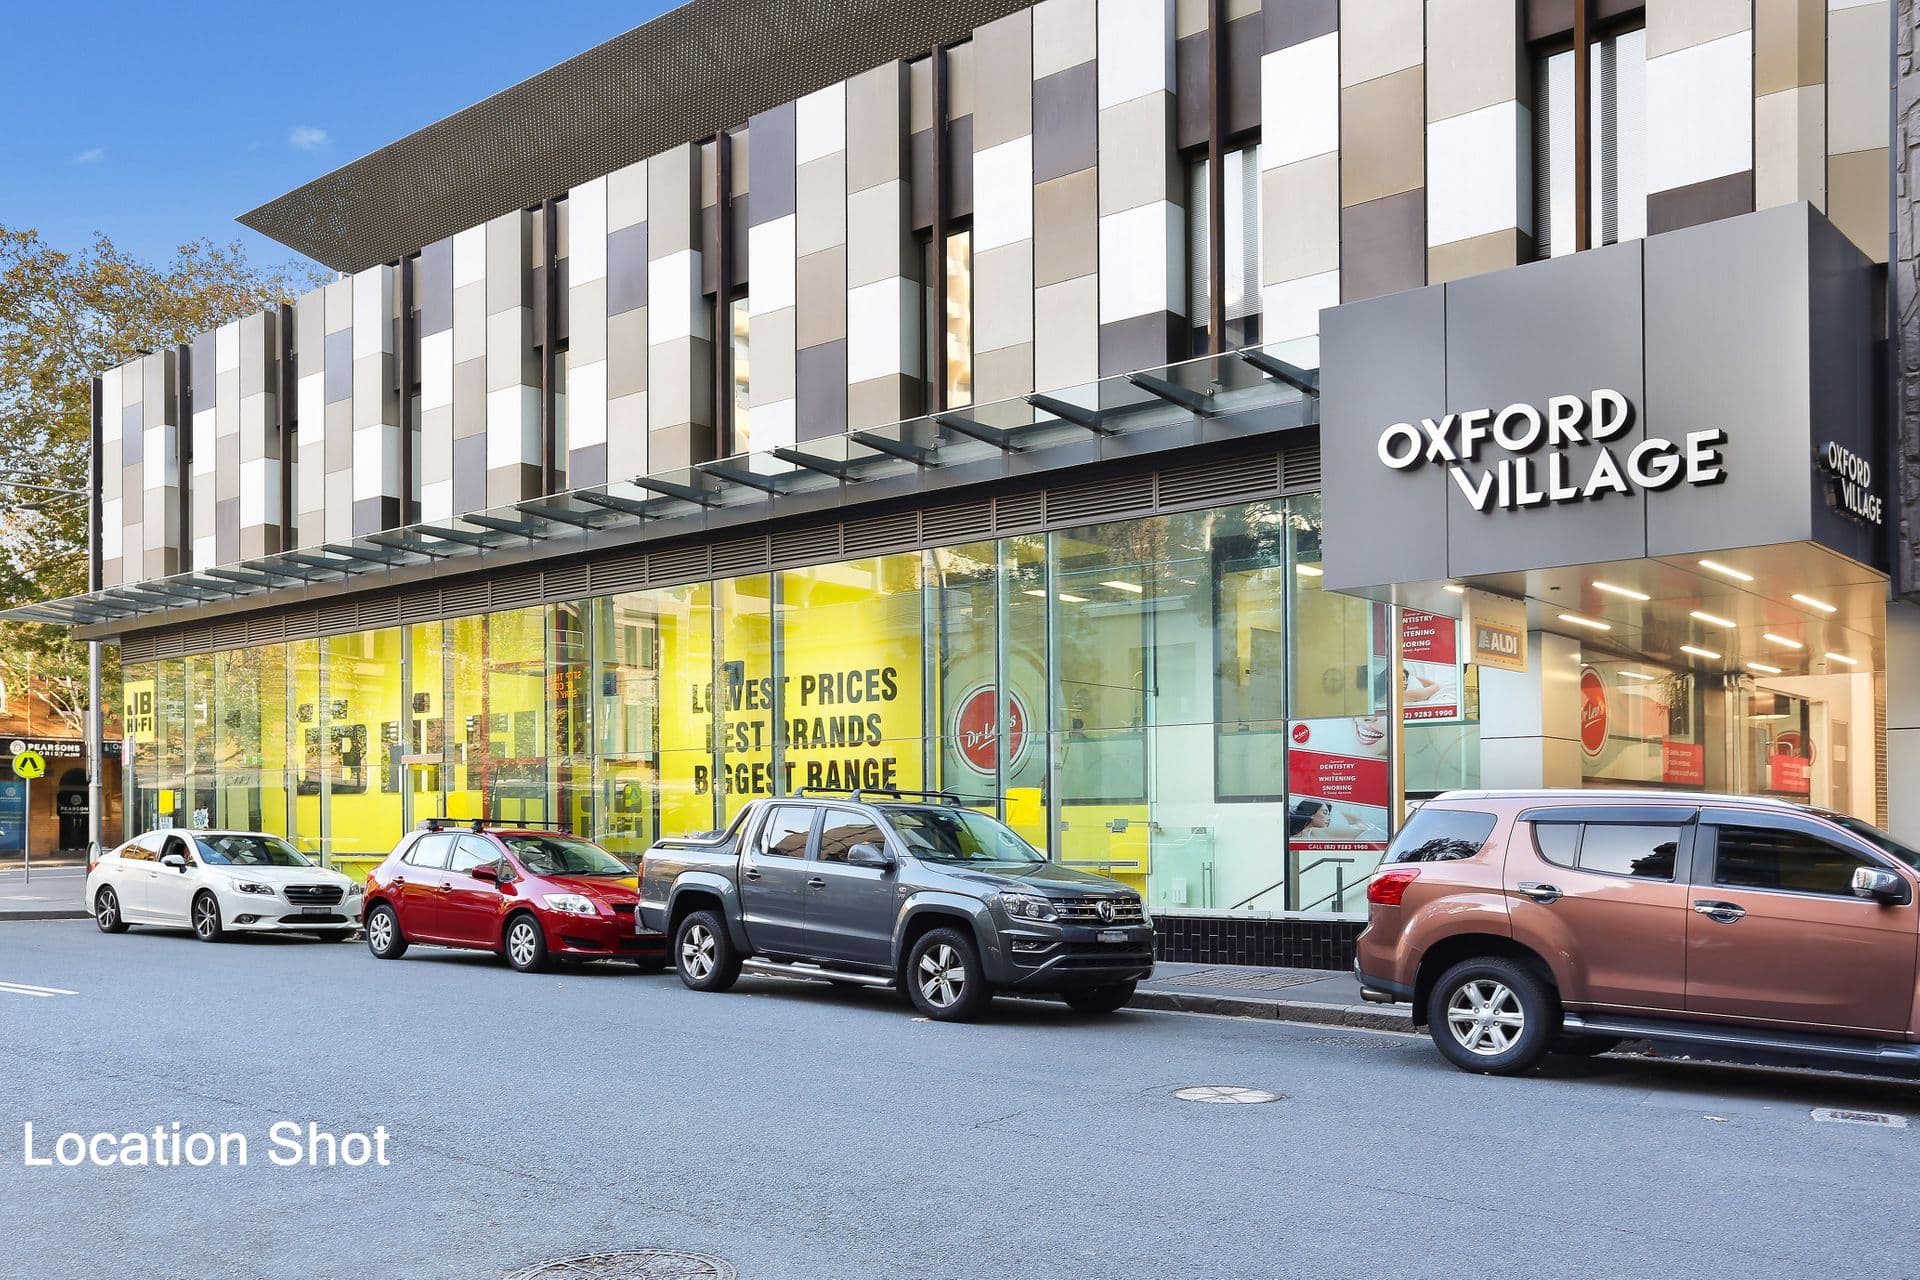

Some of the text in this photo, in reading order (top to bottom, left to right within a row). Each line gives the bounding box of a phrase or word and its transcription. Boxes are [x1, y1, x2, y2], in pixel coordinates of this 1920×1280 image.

[1377, 389, 1628, 469] OXFORD
[1450, 428, 1721, 511] VILLAGE
[1828, 441, 1870, 488] OXFORD
[1841, 478, 1882, 525] VILLAGE
[1402, 615, 1433, 623] NTISTRY
[1403, 629, 1435, 637] ITENING
[1491, 632, 1517, 655] ALDI
[127, 691, 152, 716] JB
[801, 667, 898, 706] PRICES
[27, 743, 81, 752] PEARSONS
[807, 757, 897, 792] RANGE
